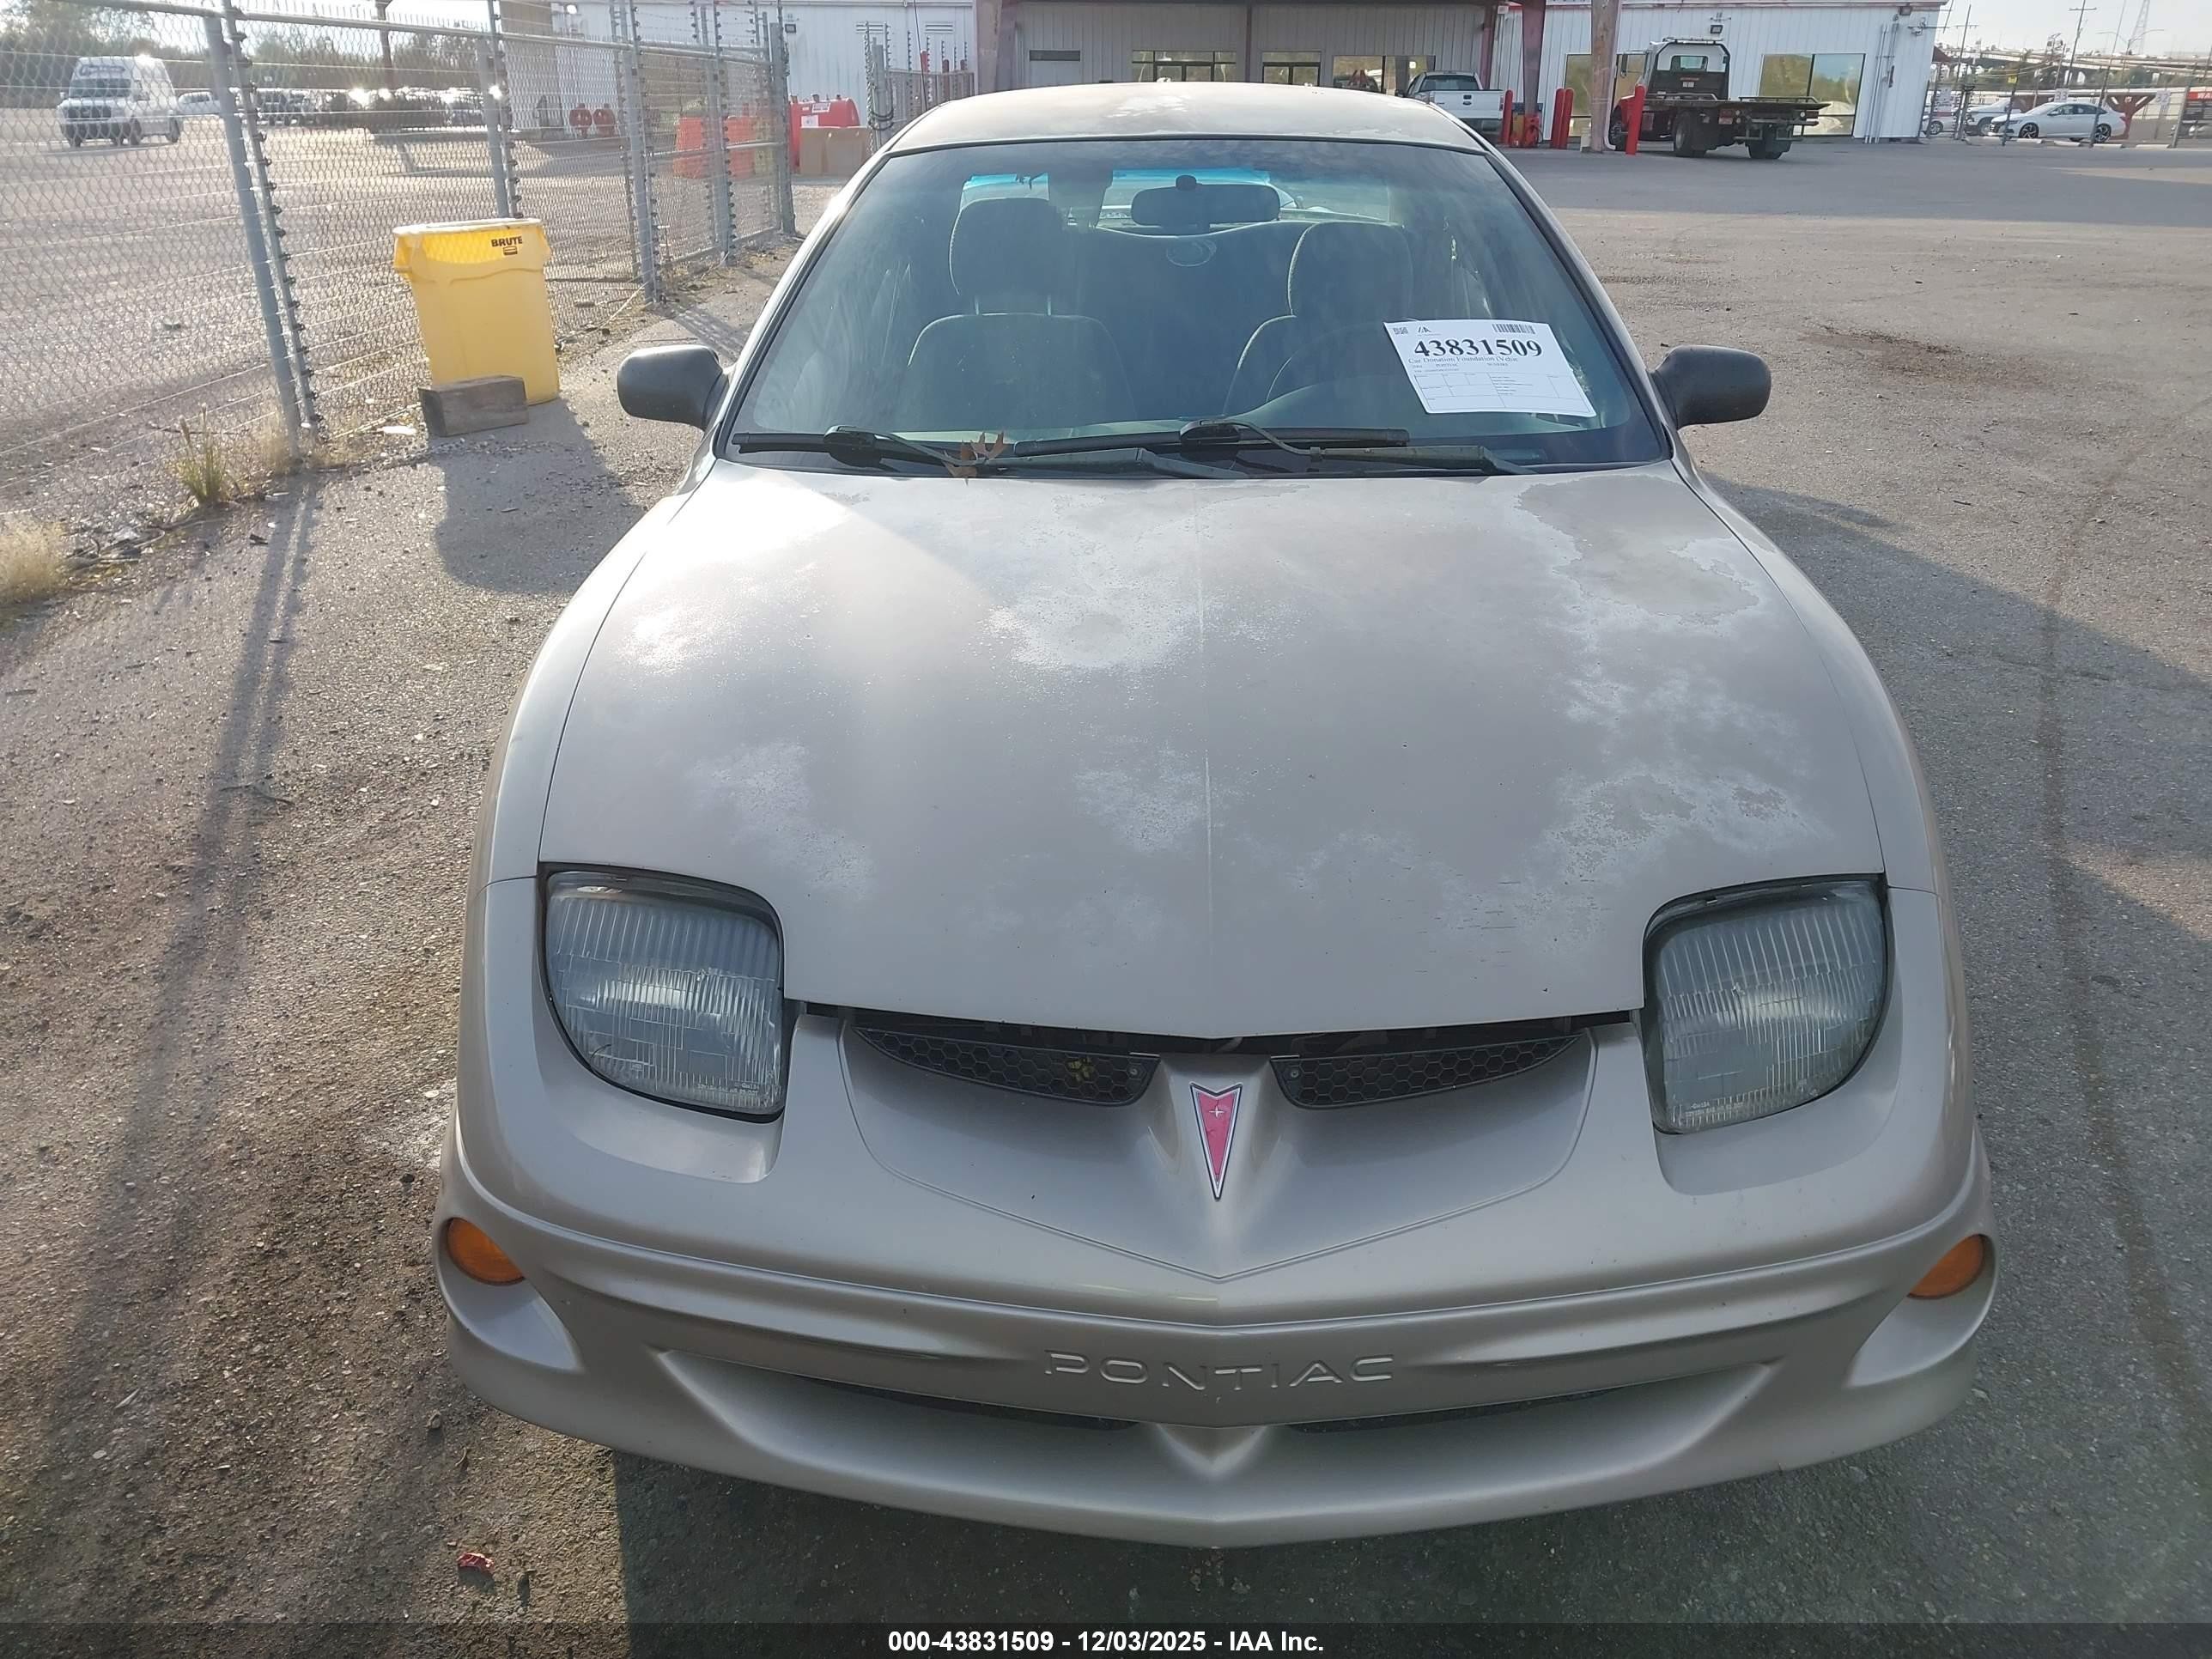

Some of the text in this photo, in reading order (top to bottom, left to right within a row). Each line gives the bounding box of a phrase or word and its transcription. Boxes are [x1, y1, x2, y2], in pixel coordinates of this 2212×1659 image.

[491, 236, 523, 247] BRUTE
[1414, 339, 1542, 357] 43831509
[1045, 1350, 1395, 1390] PONTIAC
